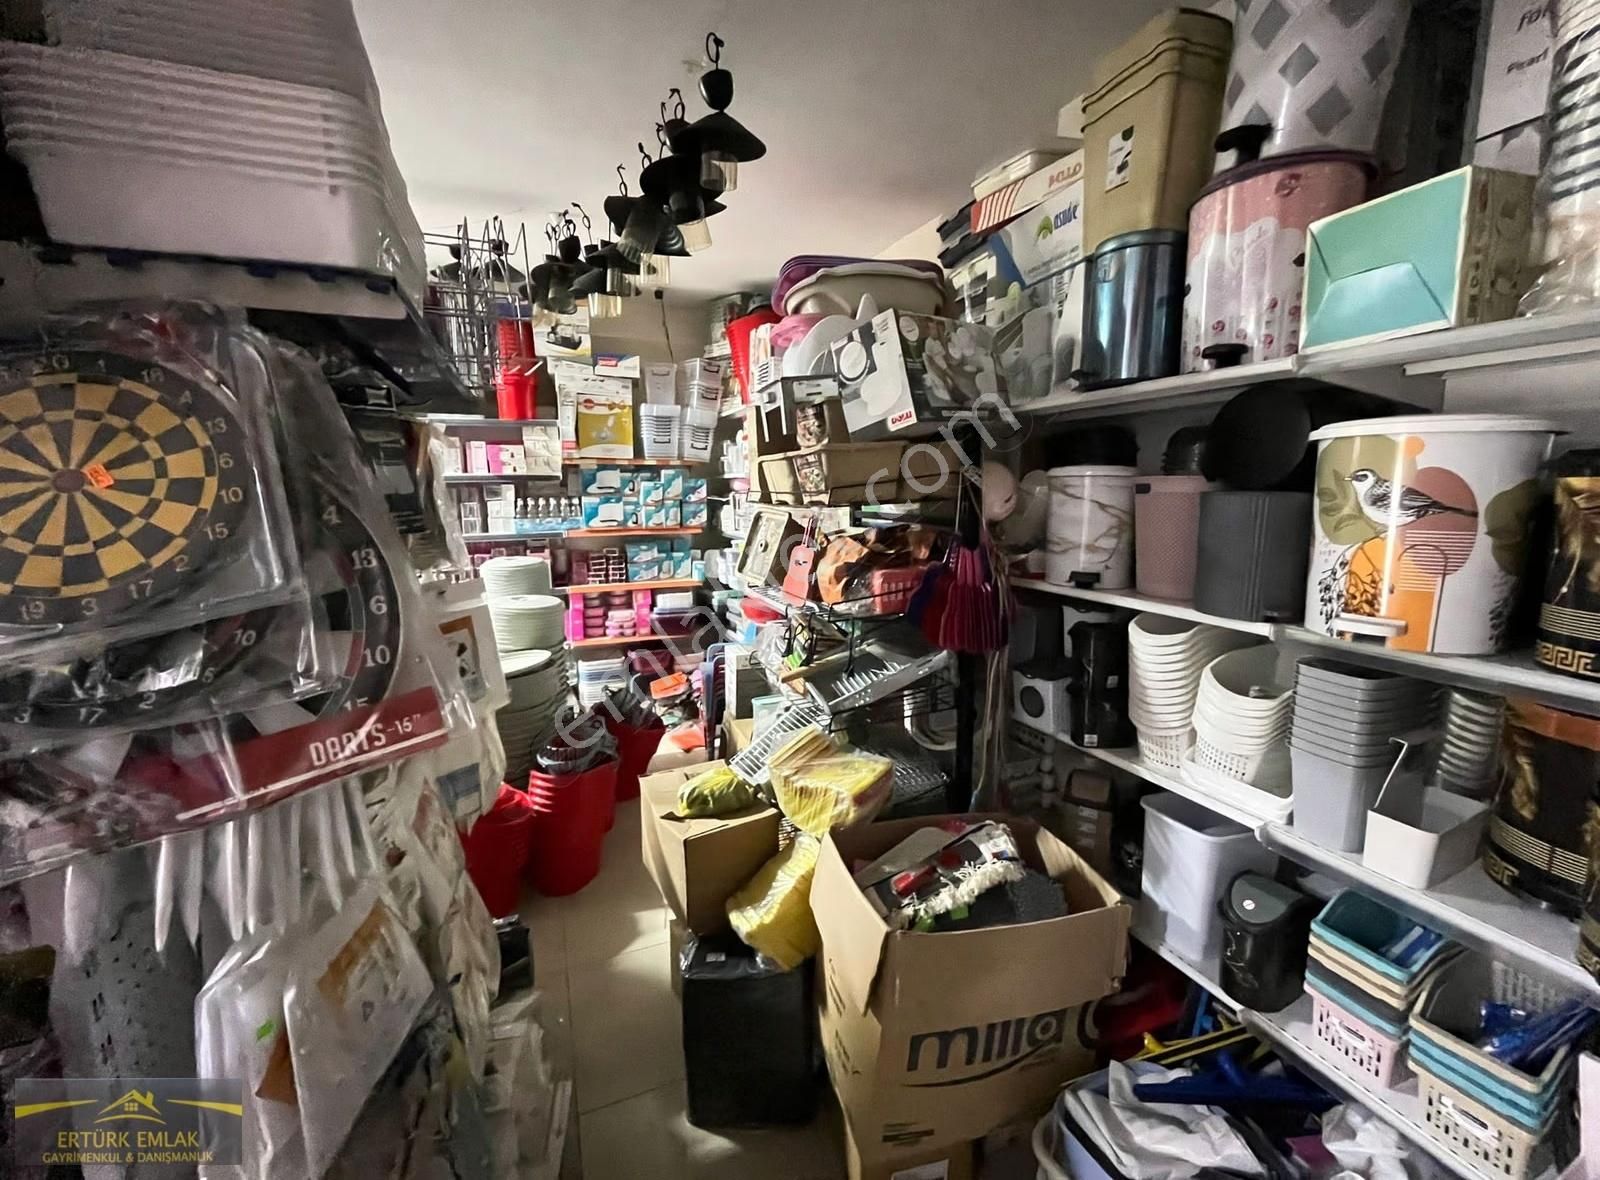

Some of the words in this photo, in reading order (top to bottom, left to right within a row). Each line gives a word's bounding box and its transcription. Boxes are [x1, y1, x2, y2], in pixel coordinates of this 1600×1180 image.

[206, 417, 227, 434] 13
[219, 452, 233, 469] 6
[219, 486, 243, 505] 10
[322, 504, 341, 525] 4
[203, 522, 229, 541] 15
[173, 554, 190, 572] 2
[351, 548, 377, 570] 13
[128, 579, 154, 599] 17
[81, 598, 99, 616] 3
[369, 595, 387, 615] 6
[233, 629, 257, 646] 10
[363, 645, 391, 668] 10
[139, 692, 156, 709] 2
